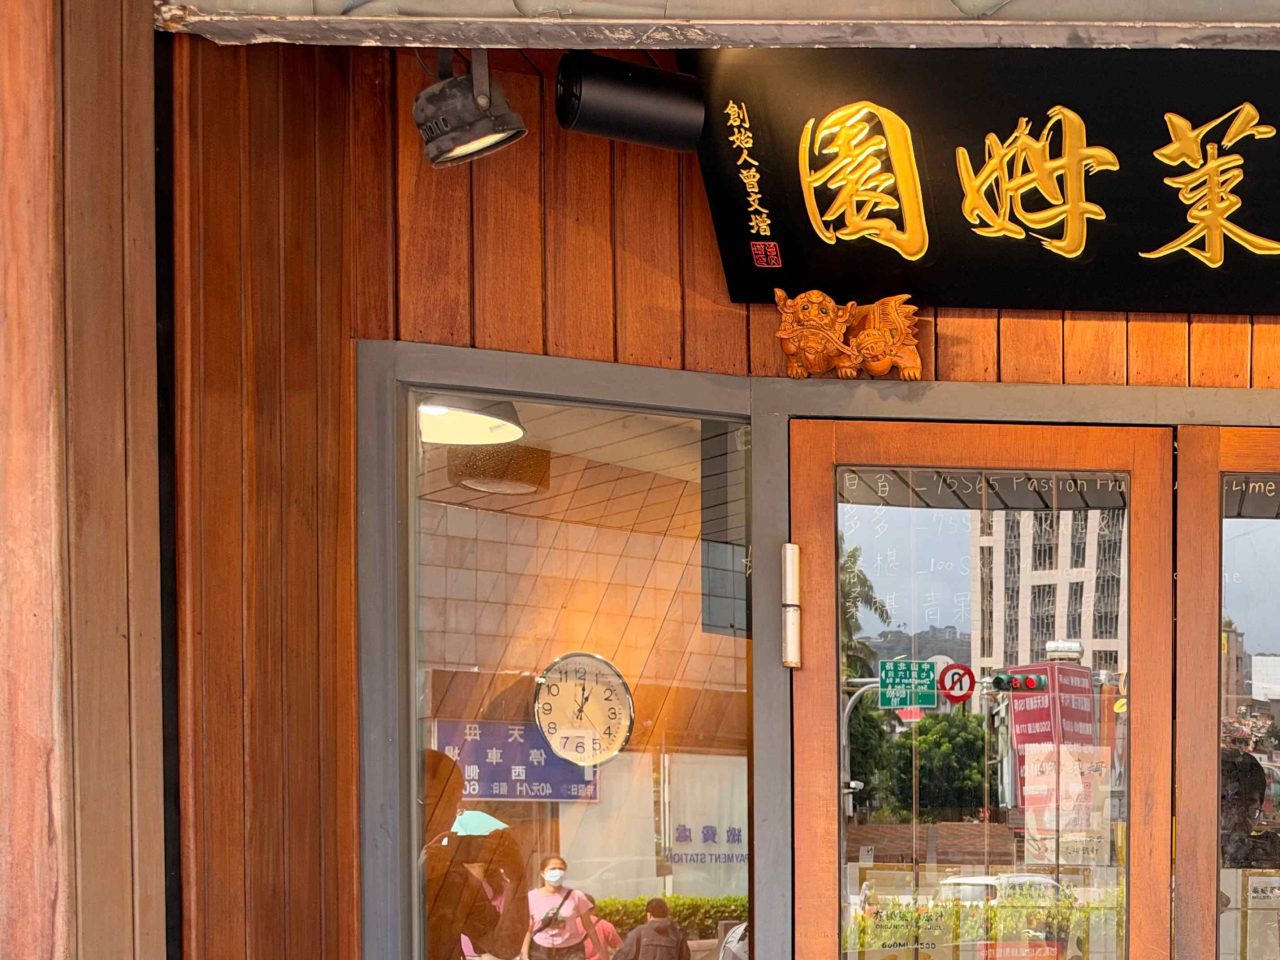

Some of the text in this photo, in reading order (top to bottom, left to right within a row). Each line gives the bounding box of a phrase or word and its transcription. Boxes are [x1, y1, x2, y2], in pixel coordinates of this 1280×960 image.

[724, 100, 771, 236] 創始人曾文增
[559, 671, 568, 683] 11
[547, 683, 560, 696] 10
[604, 688, 613, 701] 2
[543, 702, 552, 715] 9
[608, 707, 617, 720] 3
[548, 722, 557, 735] 8
[603, 726, 613, 738] 4
[561, 737, 570, 749] 7
[576, 742, 585, 753] 6
[592, 738, 601, 751] 5
